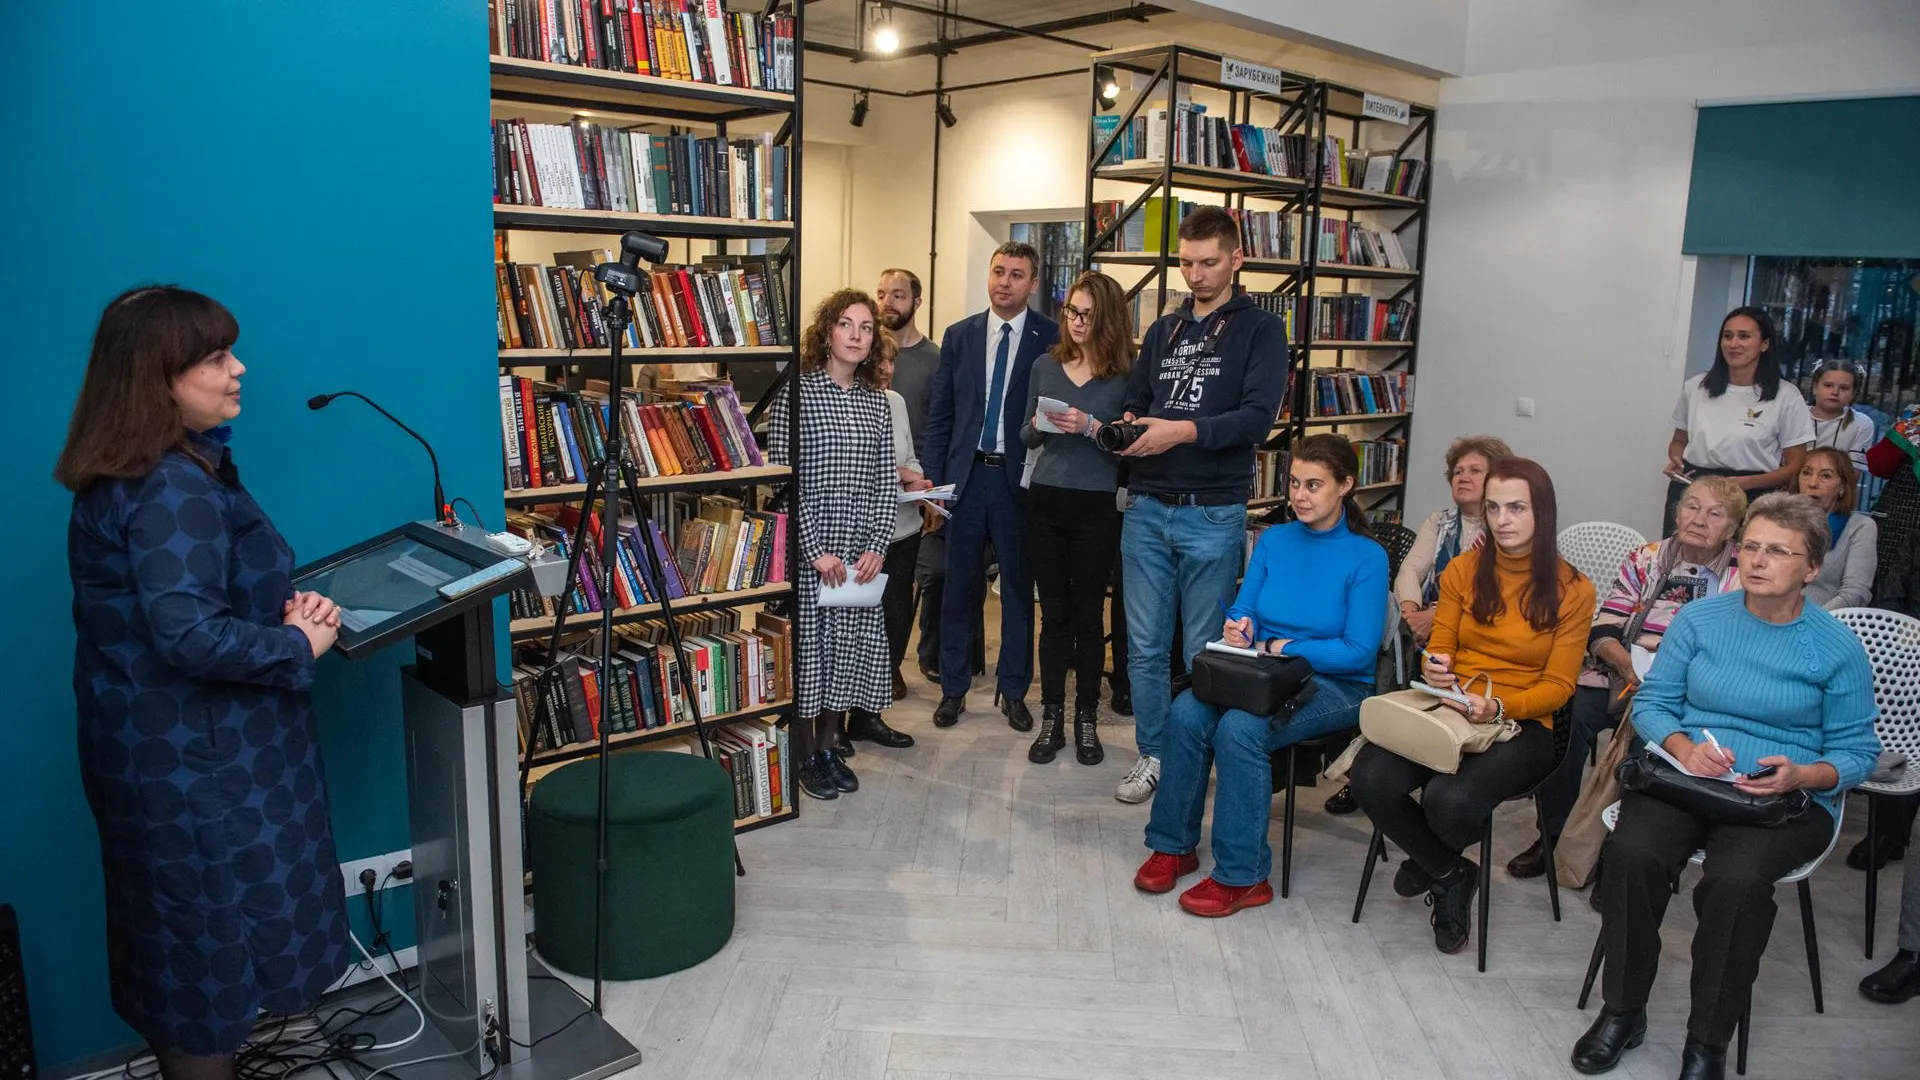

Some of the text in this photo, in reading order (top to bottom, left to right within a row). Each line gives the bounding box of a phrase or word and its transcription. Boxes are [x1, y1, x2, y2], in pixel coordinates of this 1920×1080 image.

[1234, 66, 1280, 87] ЗАРУБЕЖНАЯ
[1365, 99, 1399, 118] ЛИТЕРАТУРА
[1159, 371, 1181, 380] URBAN
[505, 397, 519, 455] христианства
[515, 391, 525, 432] БИБЛИЯ
[537, 404, 549, 455] БИБЛЕЙСКИЕ
[546, 409, 556, 448] ИСТОРИИ
[529, 428, 539, 468] ПРАВОСЛАВИЕ
[758, 747, 770, 814] МИФОЛОГИЯ
